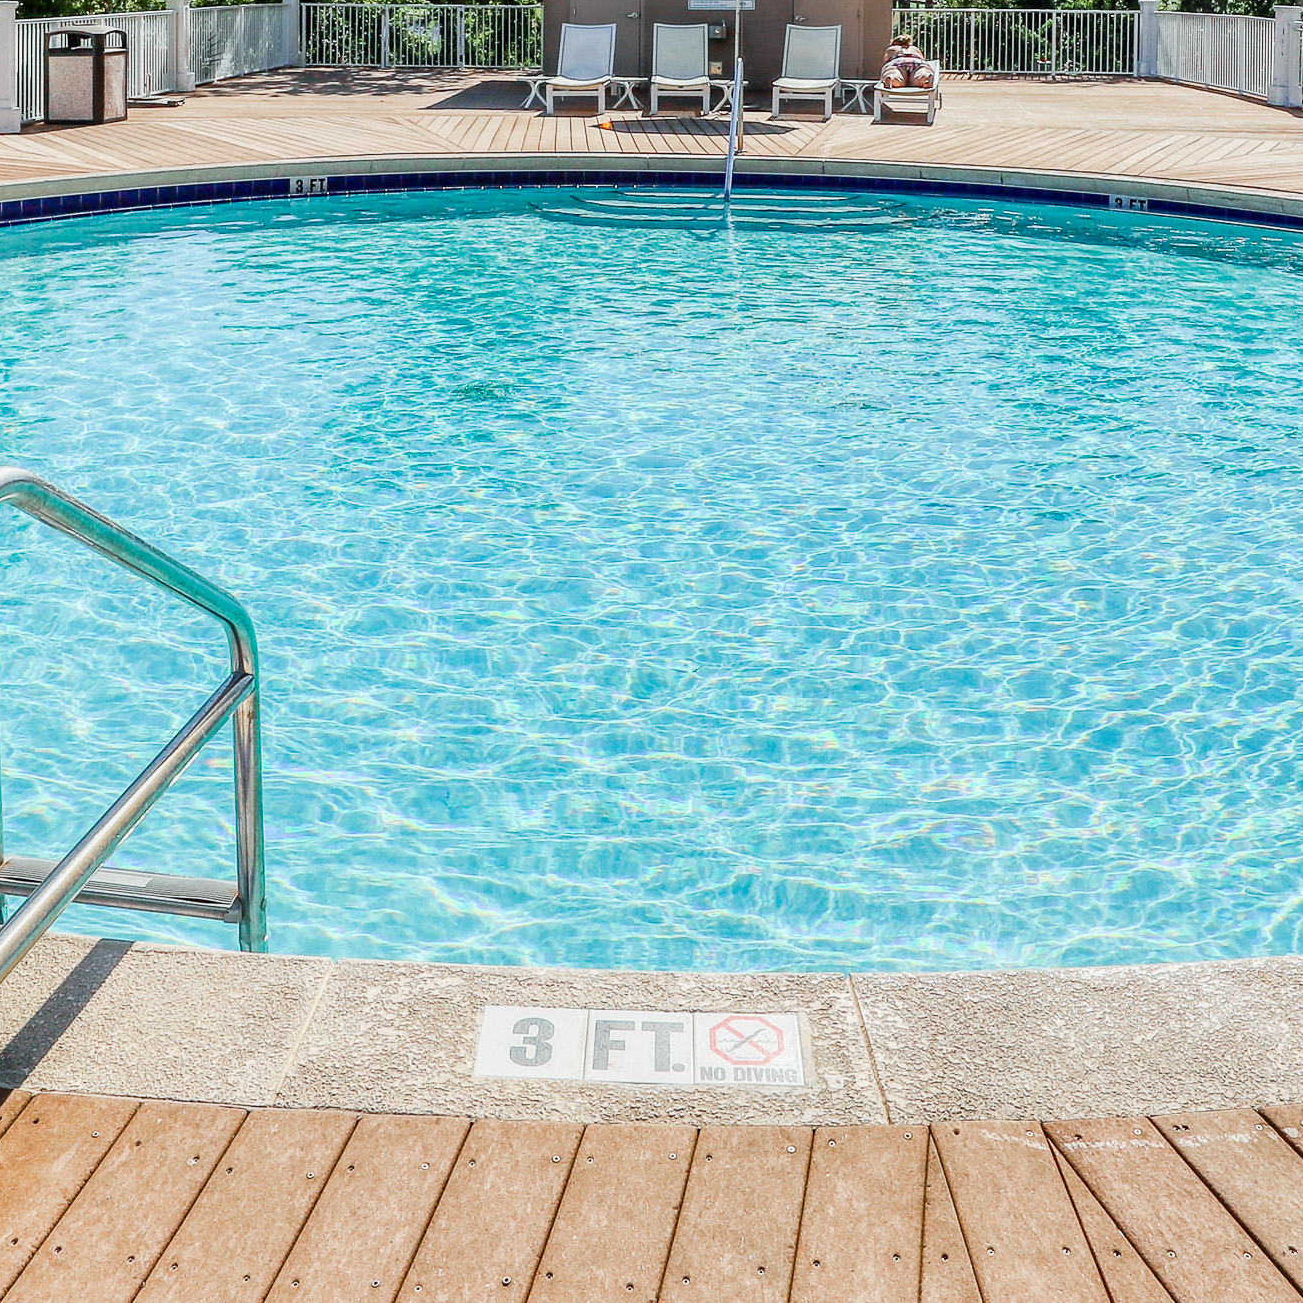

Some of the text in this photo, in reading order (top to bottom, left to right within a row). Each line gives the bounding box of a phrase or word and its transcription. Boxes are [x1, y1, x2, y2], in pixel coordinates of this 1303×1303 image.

[295, 179, 304, 193] 3
[508, 1016, 556, 1068] 3
[700, 1066, 798, 1083] NO DIVING
